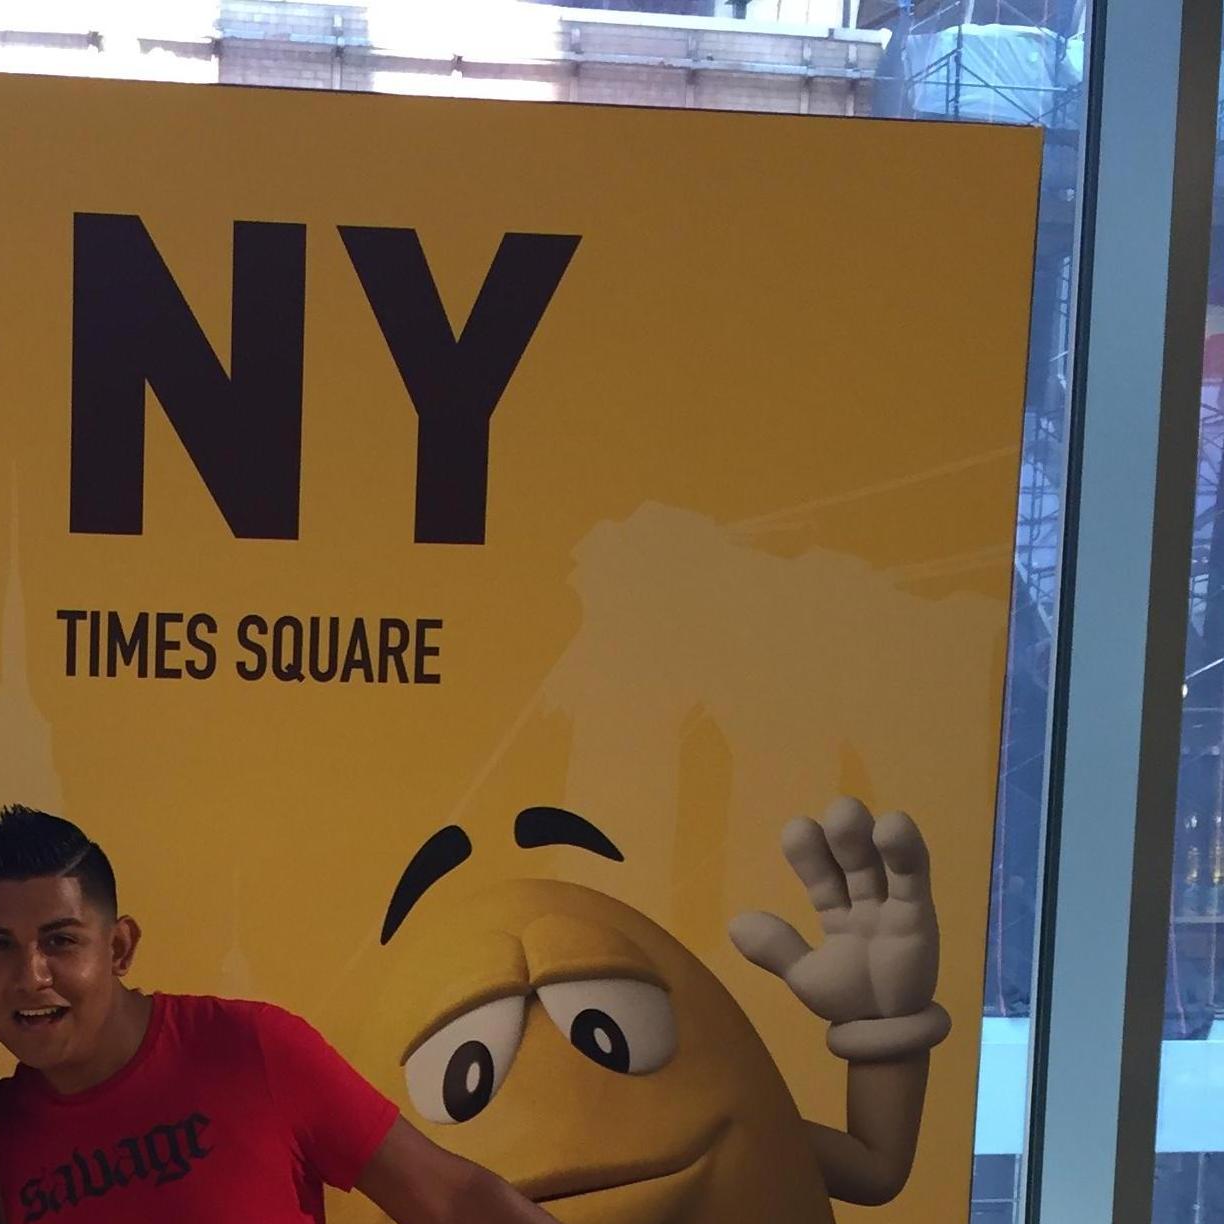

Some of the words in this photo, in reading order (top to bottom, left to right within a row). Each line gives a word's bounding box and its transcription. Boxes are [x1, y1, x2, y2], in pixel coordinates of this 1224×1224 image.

[70, 212, 583, 544] NY
[56, 610, 218, 680] TIMES
[236, 614, 443, 684] SQUARE
